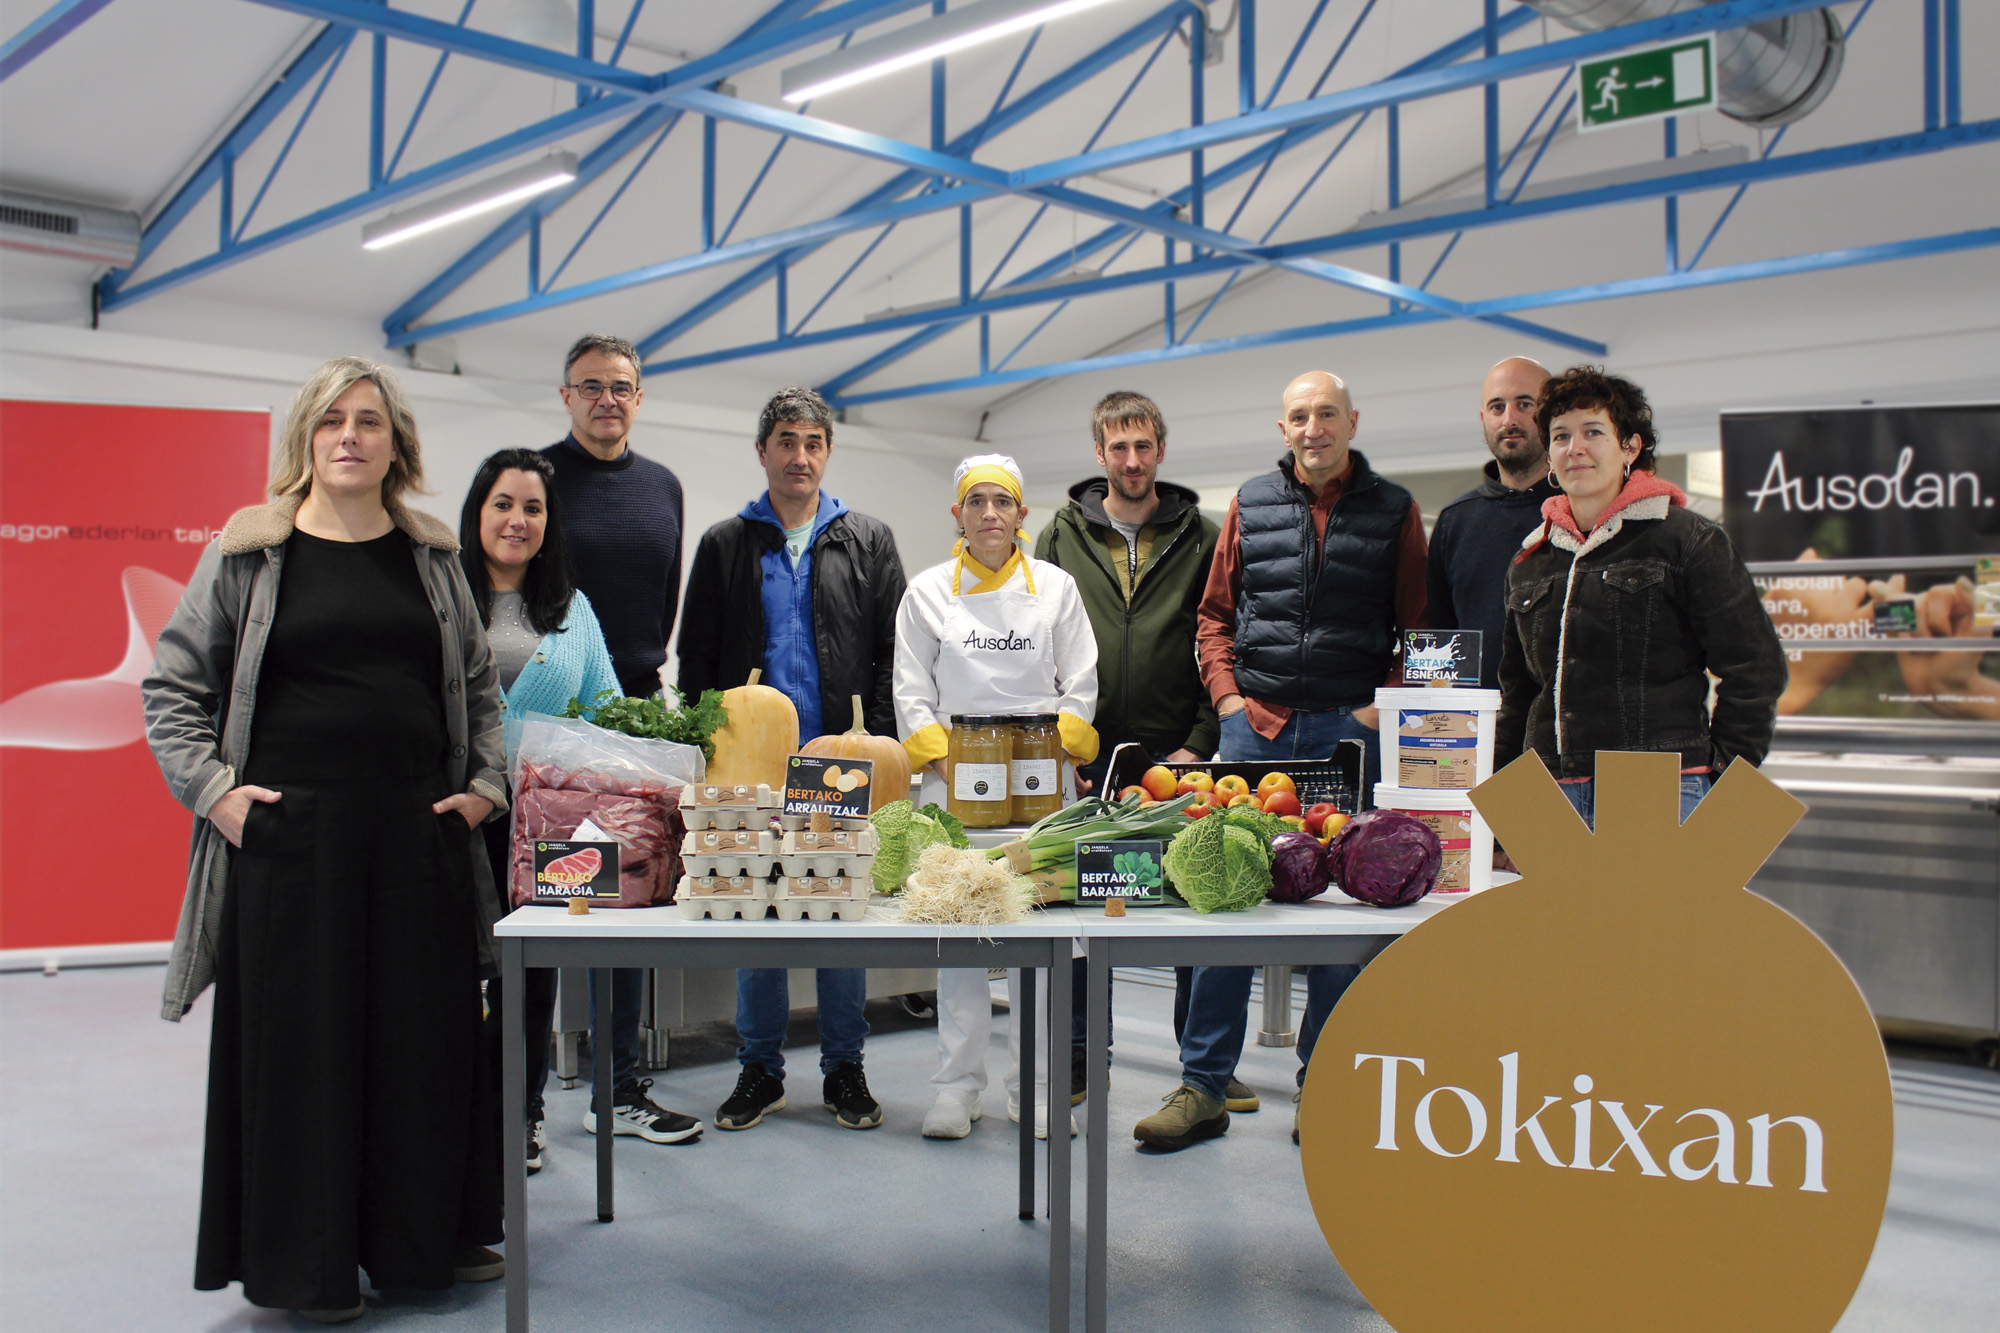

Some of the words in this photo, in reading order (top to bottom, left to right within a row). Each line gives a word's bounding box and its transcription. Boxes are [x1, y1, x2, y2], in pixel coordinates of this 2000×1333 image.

[1747, 446, 1995, 512] Ausolan.
[962, 629, 1035, 651] Ausolan.
[1406, 657, 1456, 669] BERTAKO
[1405, 669, 1459, 680] ESNEKIAK
[787, 788, 843, 802] BERTAKO
[785, 801, 860, 817] ARRAUTZAK
[537, 872, 593, 883] BERTAKO
[1081, 872, 1137, 883] BERTAKO
[537, 885, 595, 896] HARAGIA
[1081, 886, 1150, 897] BARAZKIAK
[1354, 1051, 1829, 1193] Tokixan
